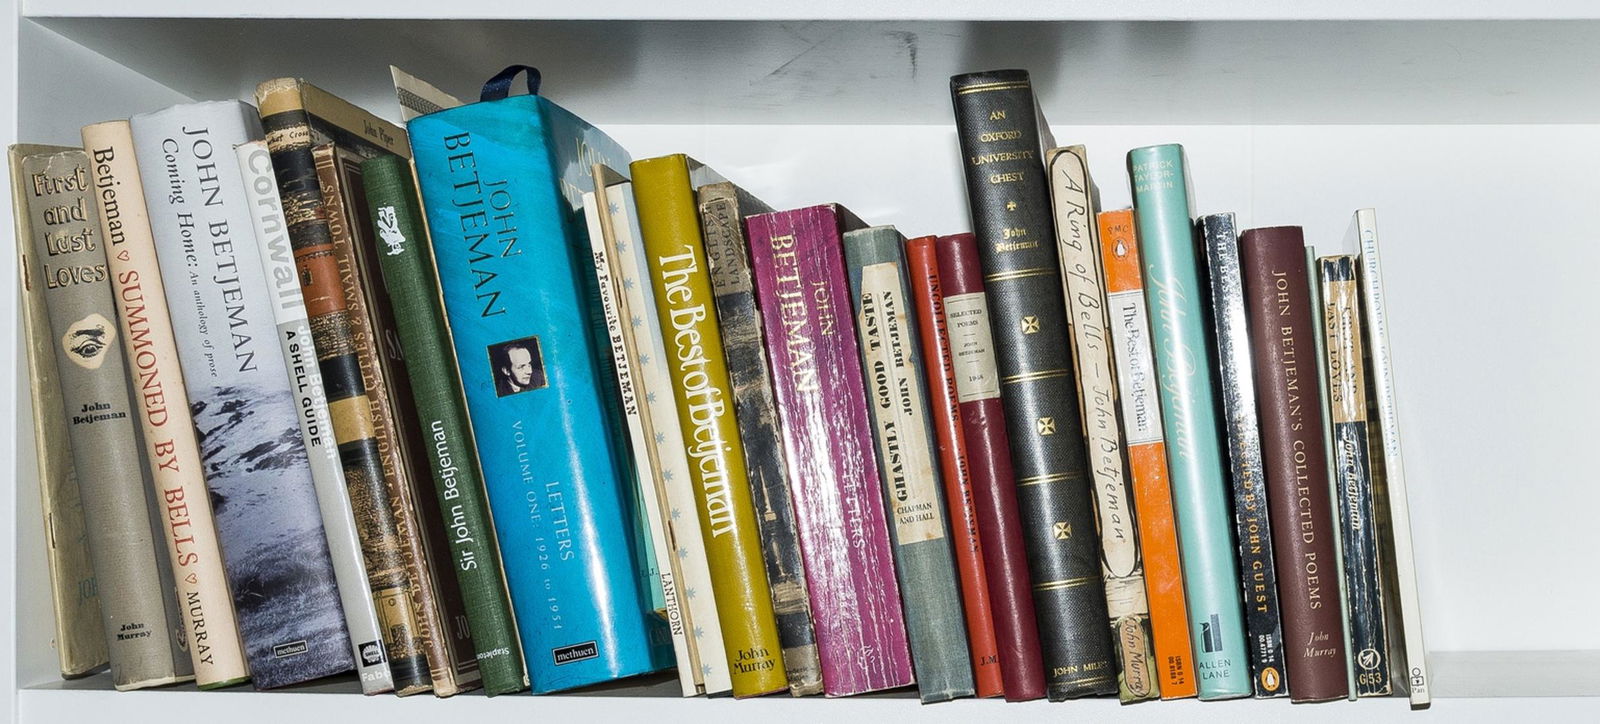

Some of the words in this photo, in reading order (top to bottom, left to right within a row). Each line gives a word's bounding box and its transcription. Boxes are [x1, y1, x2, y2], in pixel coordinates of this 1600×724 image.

[980, 130, 1022, 143] OXFORD
[990, 110, 1006, 121] AN
[162, 138, 185, 204] Coming
[971, 150, 1034, 166] UNIVERSITY
[989, 171, 1024, 184] CHEST
[1133, 159, 1174, 171] PATRICK
[31, 164, 89, 197] First
[93, 145, 126, 246] Betjeman
[1062, 169, 1084, 194] A
[1137, 181, 1173, 193] MARTIN
[43, 197, 87, 226] and
[248, 149, 307, 310] Cornwall
[321, 184, 347, 250] TOWNS
[443, 131, 507, 318] BETJEMAN
[483, 179, 523, 258] JOHN
[1063, 200, 1087, 252] Ring
[1107, 225, 1129, 235] PMC
[45, 228, 96, 257] Last
[177, 212, 198, 268] Home:
[183, 126, 223, 207] JOHN
[208, 219, 256, 374] BETJEMAN
[717, 202, 741, 286] LANDSCAPE
[1003, 228, 1026, 239] John
[44, 262, 108, 289] Loves
[190, 270, 199, 286] An
[337, 253, 359, 312] SMALL
[594, 250, 605, 272] My
[658, 244, 699, 306] The
[1068, 263, 1094, 287] of
[193, 289, 209, 335] anthology
[598, 273, 617, 333] Favourite
[770, 234, 819, 394] BETJEMAN
[811, 280, 835, 337] JOHN
[950, 308, 982, 319] SELECTED
[1122, 302, 1137, 330] The
[1150, 263, 1188, 332] John
[286, 330, 296, 341] A
[669, 303, 712, 372] Best
[861, 292, 882, 352] TASTE
[882, 291, 905, 368] BETJEMAN
[928, 274, 951, 372] UNCOLLECTED
[957, 320, 979, 329] POEMS
[1078, 291, 1102, 351] Bells
[1326, 302, 1338, 339] LAST
[118, 270, 169, 428] SUMMONED
[203, 339, 213, 350] of
[206, 352, 217, 377] prose
[354, 332, 374, 391] CITIES
[289, 343, 308, 394] SHELL
[612, 334, 637, 416] BETJEMAN
[682, 370, 722, 400] of
[874, 360, 891, 410] GOOD
[1330, 350, 1343, 403] LOVES
[81, 402, 112, 414] John
[298, 324, 316, 369] John
[308, 373, 337, 460] Betjeman
[898, 377, 914, 417] JOHN
[1093, 385, 1112, 429] John
[1162, 336, 1197, 460] Betjeman
[72, 410, 127, 426] Betjeman
[302, 396, 322, 447] GUIDE
[368, 402, 395, 477] ENGLISH
[154, 439, 179, 473] BY
[431, 419, 459, 502] Betjeman
[884, 420, 908, 502] GHASTLY
[1271, 270, 1291, 317] JOHN
[1281, 326, 1303, 432] BETJEMAN'S
[1293, 440, 1316, 545] COLLECTED
[1305, 552, 1323, 610] POEMS
[688, 399, 738, 540] Betjeman
[1096, 436, 1126, 539] Betjeman
[545, 480, 575, 562] LETTERS
[896, 502, 933, 515] CHAPMAN
[899, 515, 915, 525] AND
[916, 512, 935, 523] HALL
[1244, 493, 1257, 511] BY
[164, 486, 199, 567] BELLS
[450, 504, 474, 549] John
[512, 420, 535, 485] VOLUME
[526, 490, 542, 529] ONE:
[535, 536, 549, 571] 1926
[544, 579, 551, 590] to
[548, 597, 562, 630] 1951
[1246, 517, 1261, 554] JOHN
[461, 549, 478, 571] Sir
[661, 572, 683, 636] LANTHORN
[1252, 560, 1268, 613] GUEST
[116, 629, 153, 642] Murray
[120, 621, 145, 633] John
[186, 591, 213, 666] MURRAY
[1125, 619, 1138, 651] John
[1307, 630, 1329, 646] John
[556, 646, 595, 663] methuen
[733, 659, 776, 675] Murray
[735, 647, 769, 662] John
[1052, 665, 1078, 678] JOHN
[1128, 651, 1144, 693] Murray
[1199, 658, 1231, 669] ALLEN
[1303, 644, 1337, 659] Murray
[1203, 671, 1230, 679] LANE
